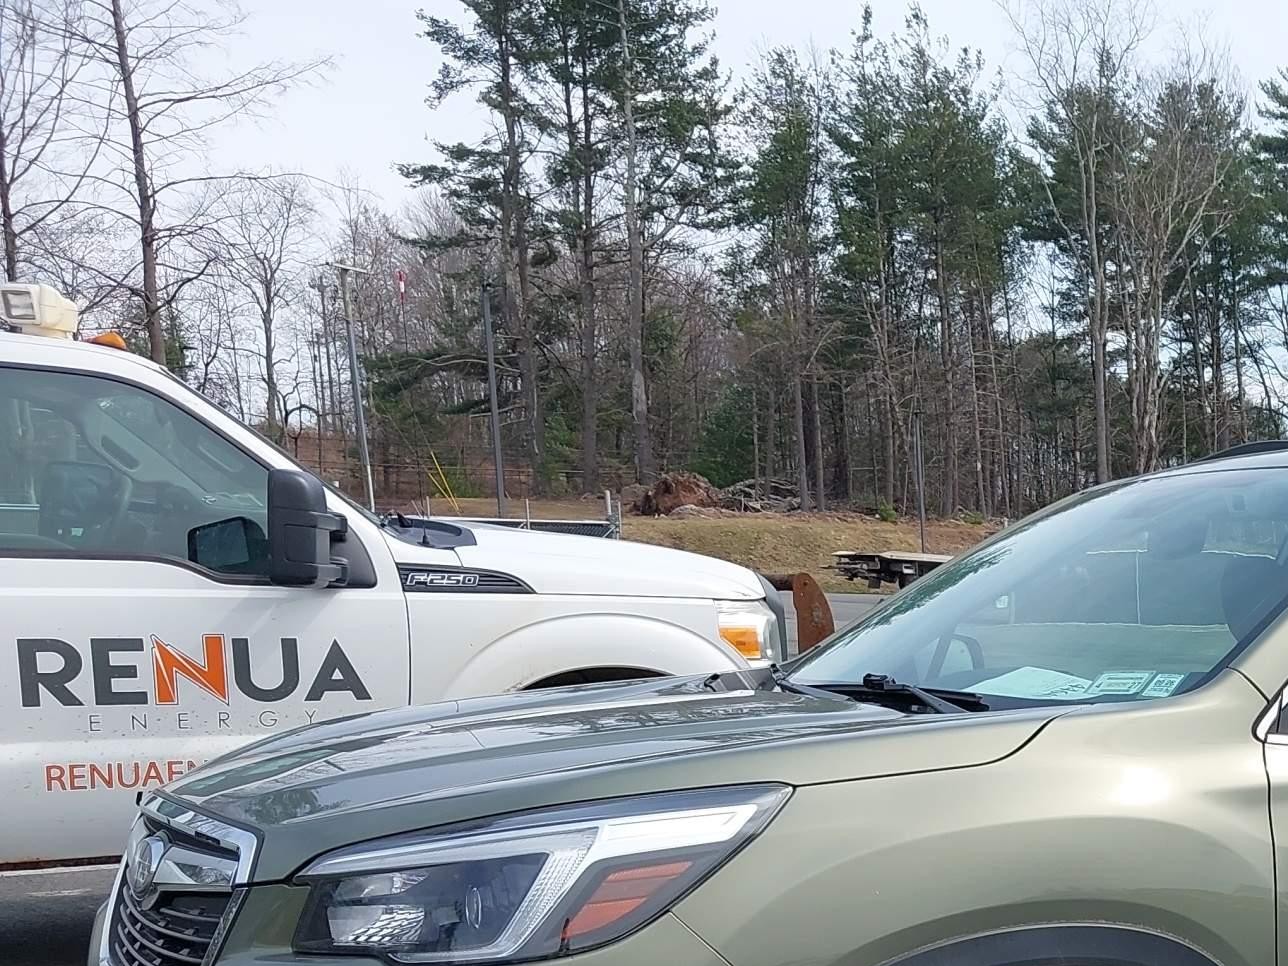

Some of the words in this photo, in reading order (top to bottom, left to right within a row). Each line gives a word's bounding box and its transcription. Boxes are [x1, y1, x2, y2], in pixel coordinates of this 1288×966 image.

[406, 572, 479, 587] F-250
[16, 633, 373, 708] RENUA
[89, 709, 318, 732] ENERGY
